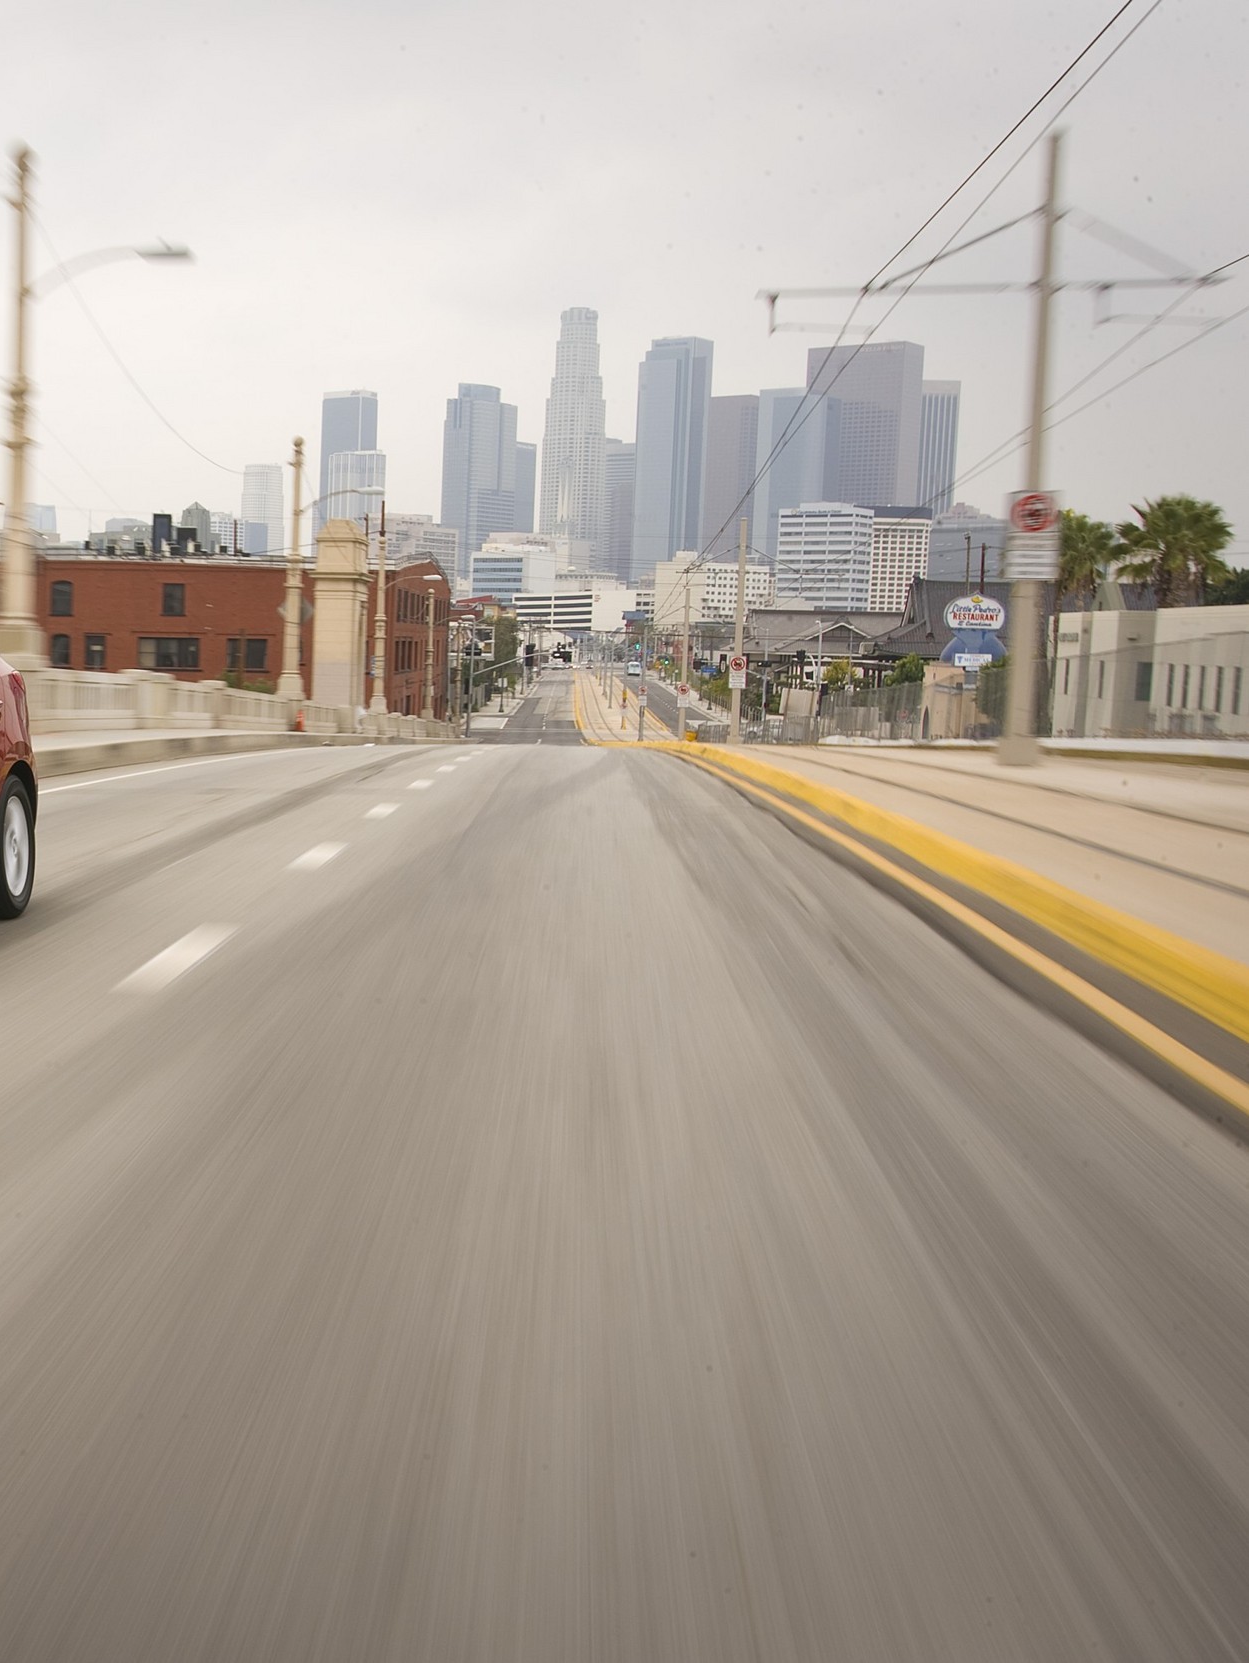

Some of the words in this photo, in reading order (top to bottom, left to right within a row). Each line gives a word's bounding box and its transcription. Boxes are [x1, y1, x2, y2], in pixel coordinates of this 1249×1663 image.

[950, 603, 972, 613] Little
[973, 604, 1001, 613] Pedro's
[953, 613, 999, 621] RESTAURANT
